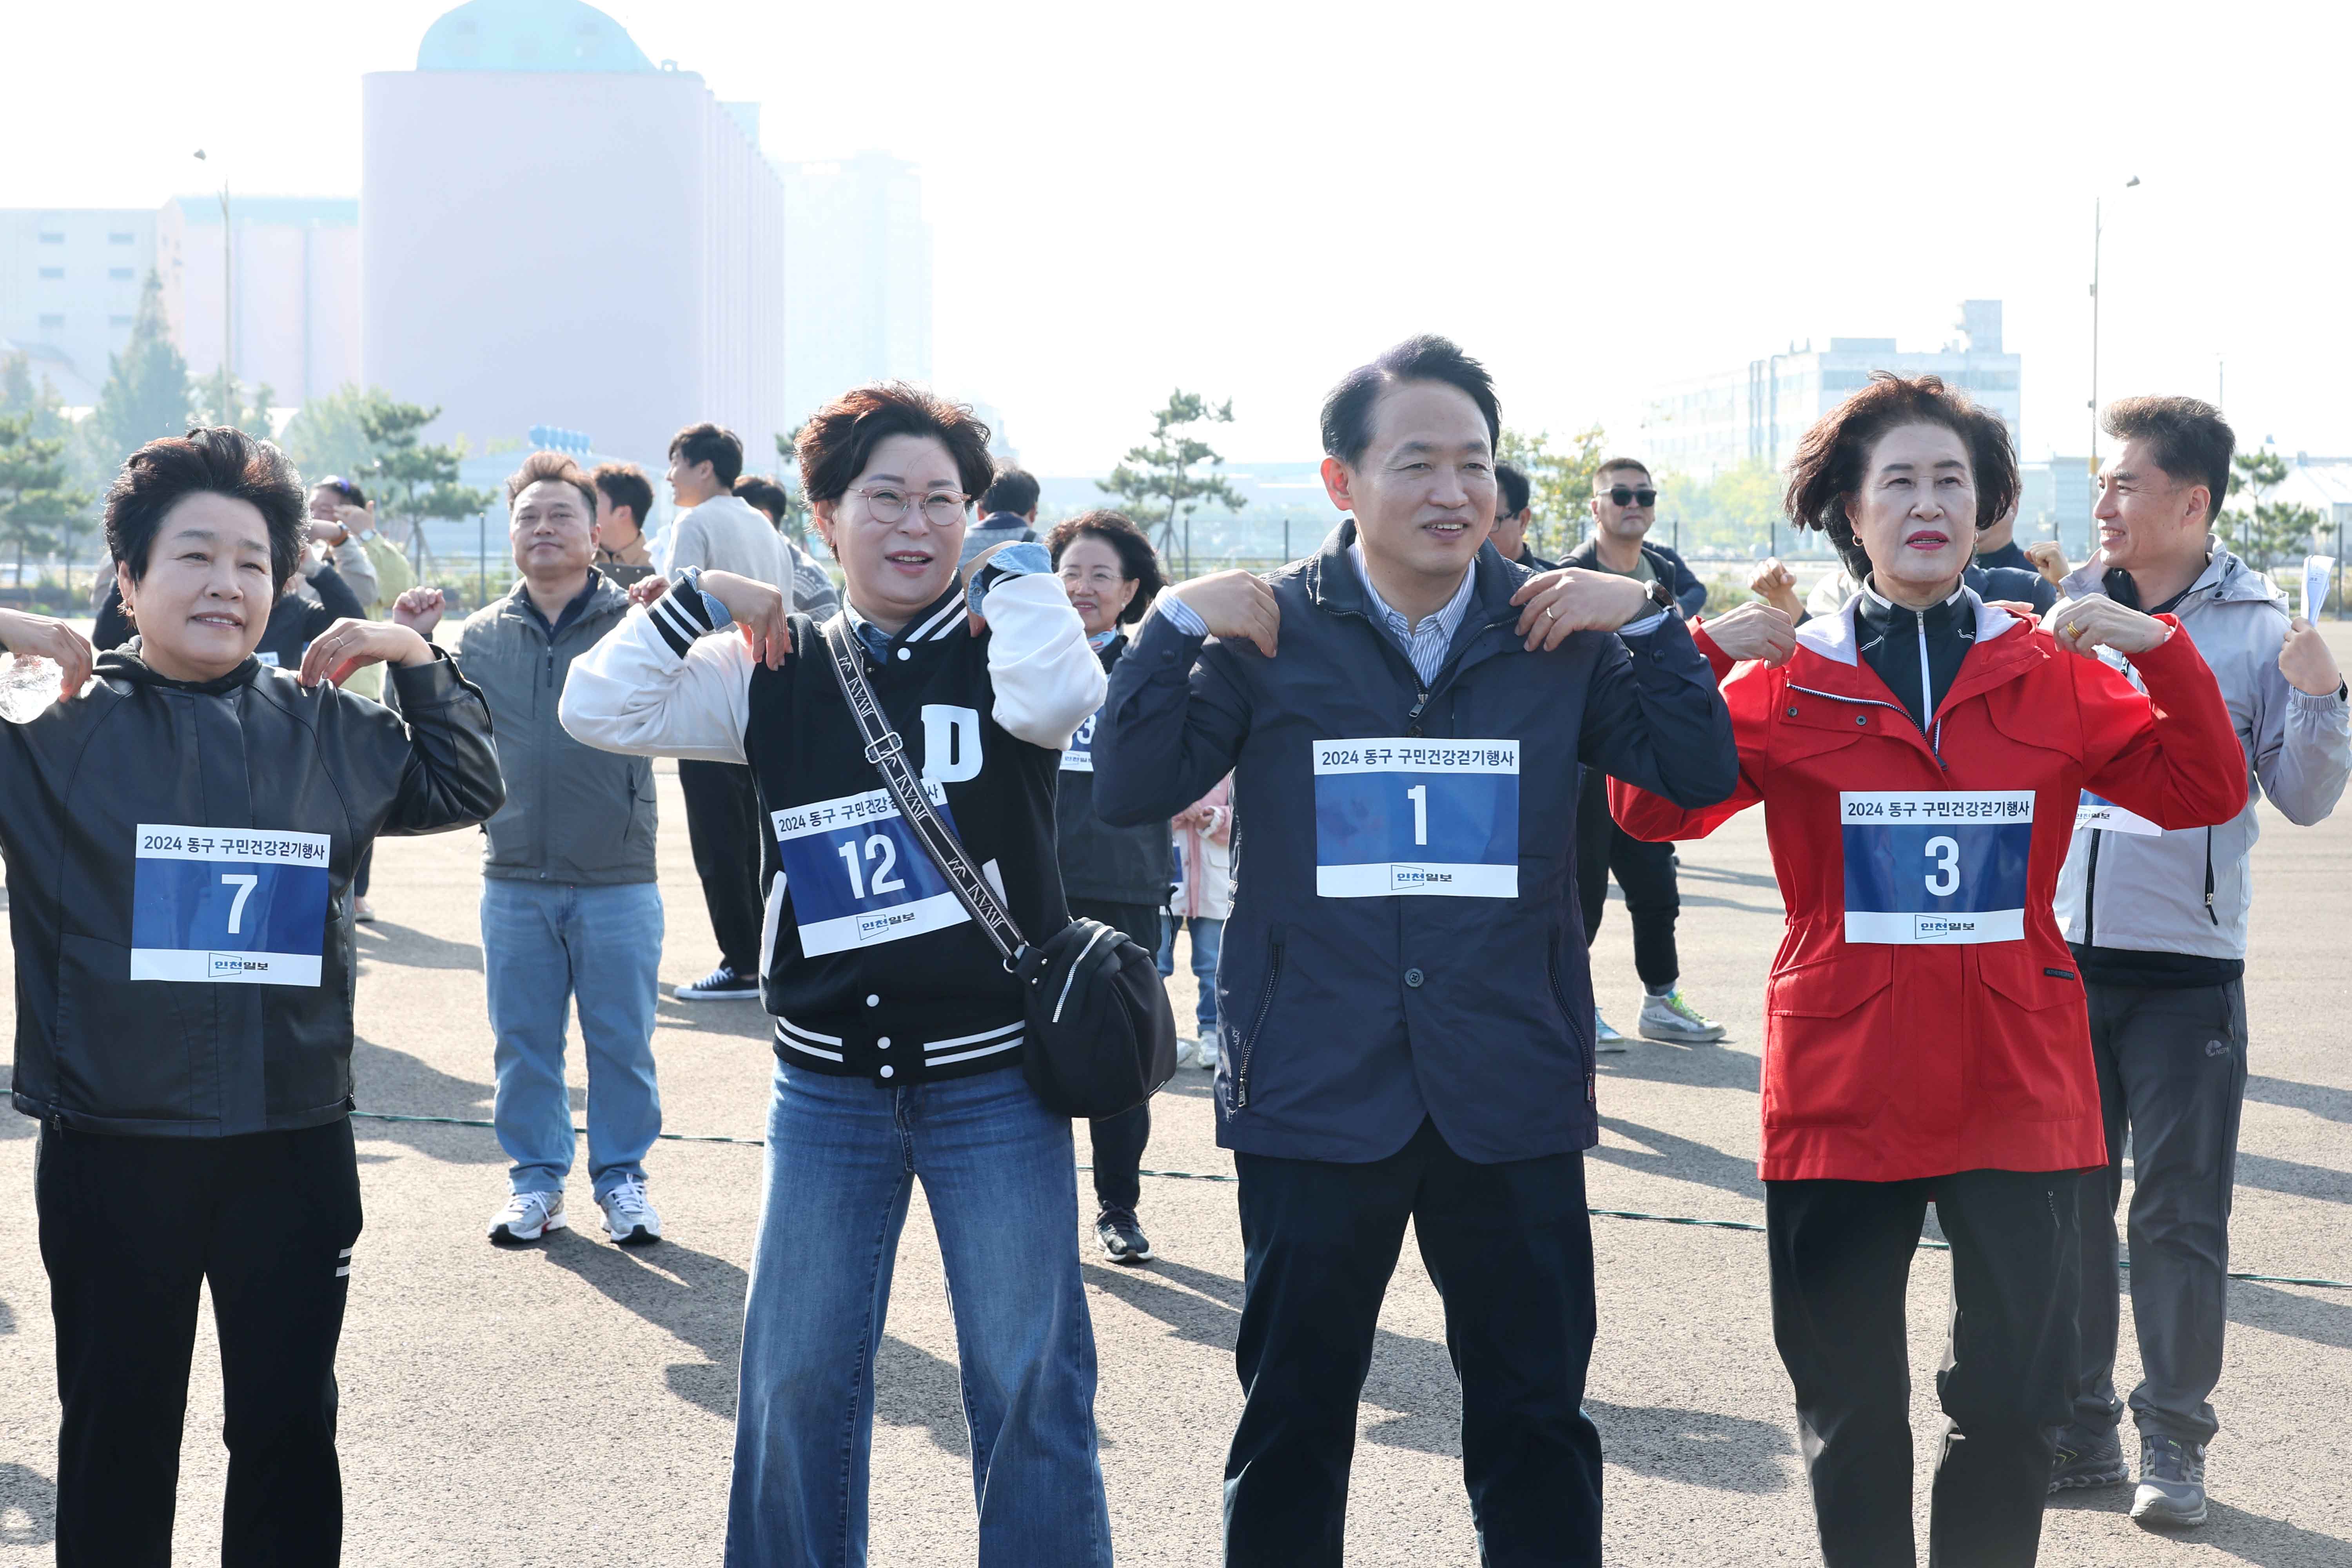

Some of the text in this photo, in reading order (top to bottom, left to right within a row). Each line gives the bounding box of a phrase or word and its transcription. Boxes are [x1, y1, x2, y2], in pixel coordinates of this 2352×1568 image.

[848, 677, 875, 717] JIWANI
[921, 704, 983, 782] D
[1321, 749, 1514, 766] 2024 동구 구민건강걷기행사
[895, 774, 929, 820] JIWANI
[1847, 800, 2030, 817] 2024 동구 구민건강걷기행사
[778, 816, 806, 832] 2024
[809, 808, 836, 827] 동구
[1407, 785, 1427, 845] 1
[144, 835, 325, 860] 2024 동구 구민건강걷기행사
[838, 834, 906, 899] 12
[1397, 873, 1453, 882] 인천일보
[1925, 836, 1960, 897] 3
[221, 874, 258, 934] 7
[967, 883, 1005, 929] JIWANI
[862, 912, 915, 931] 인천일보
[1920, 922, 1975, 931] 인천일보
[214, 961, 269, 971] 인천일보
